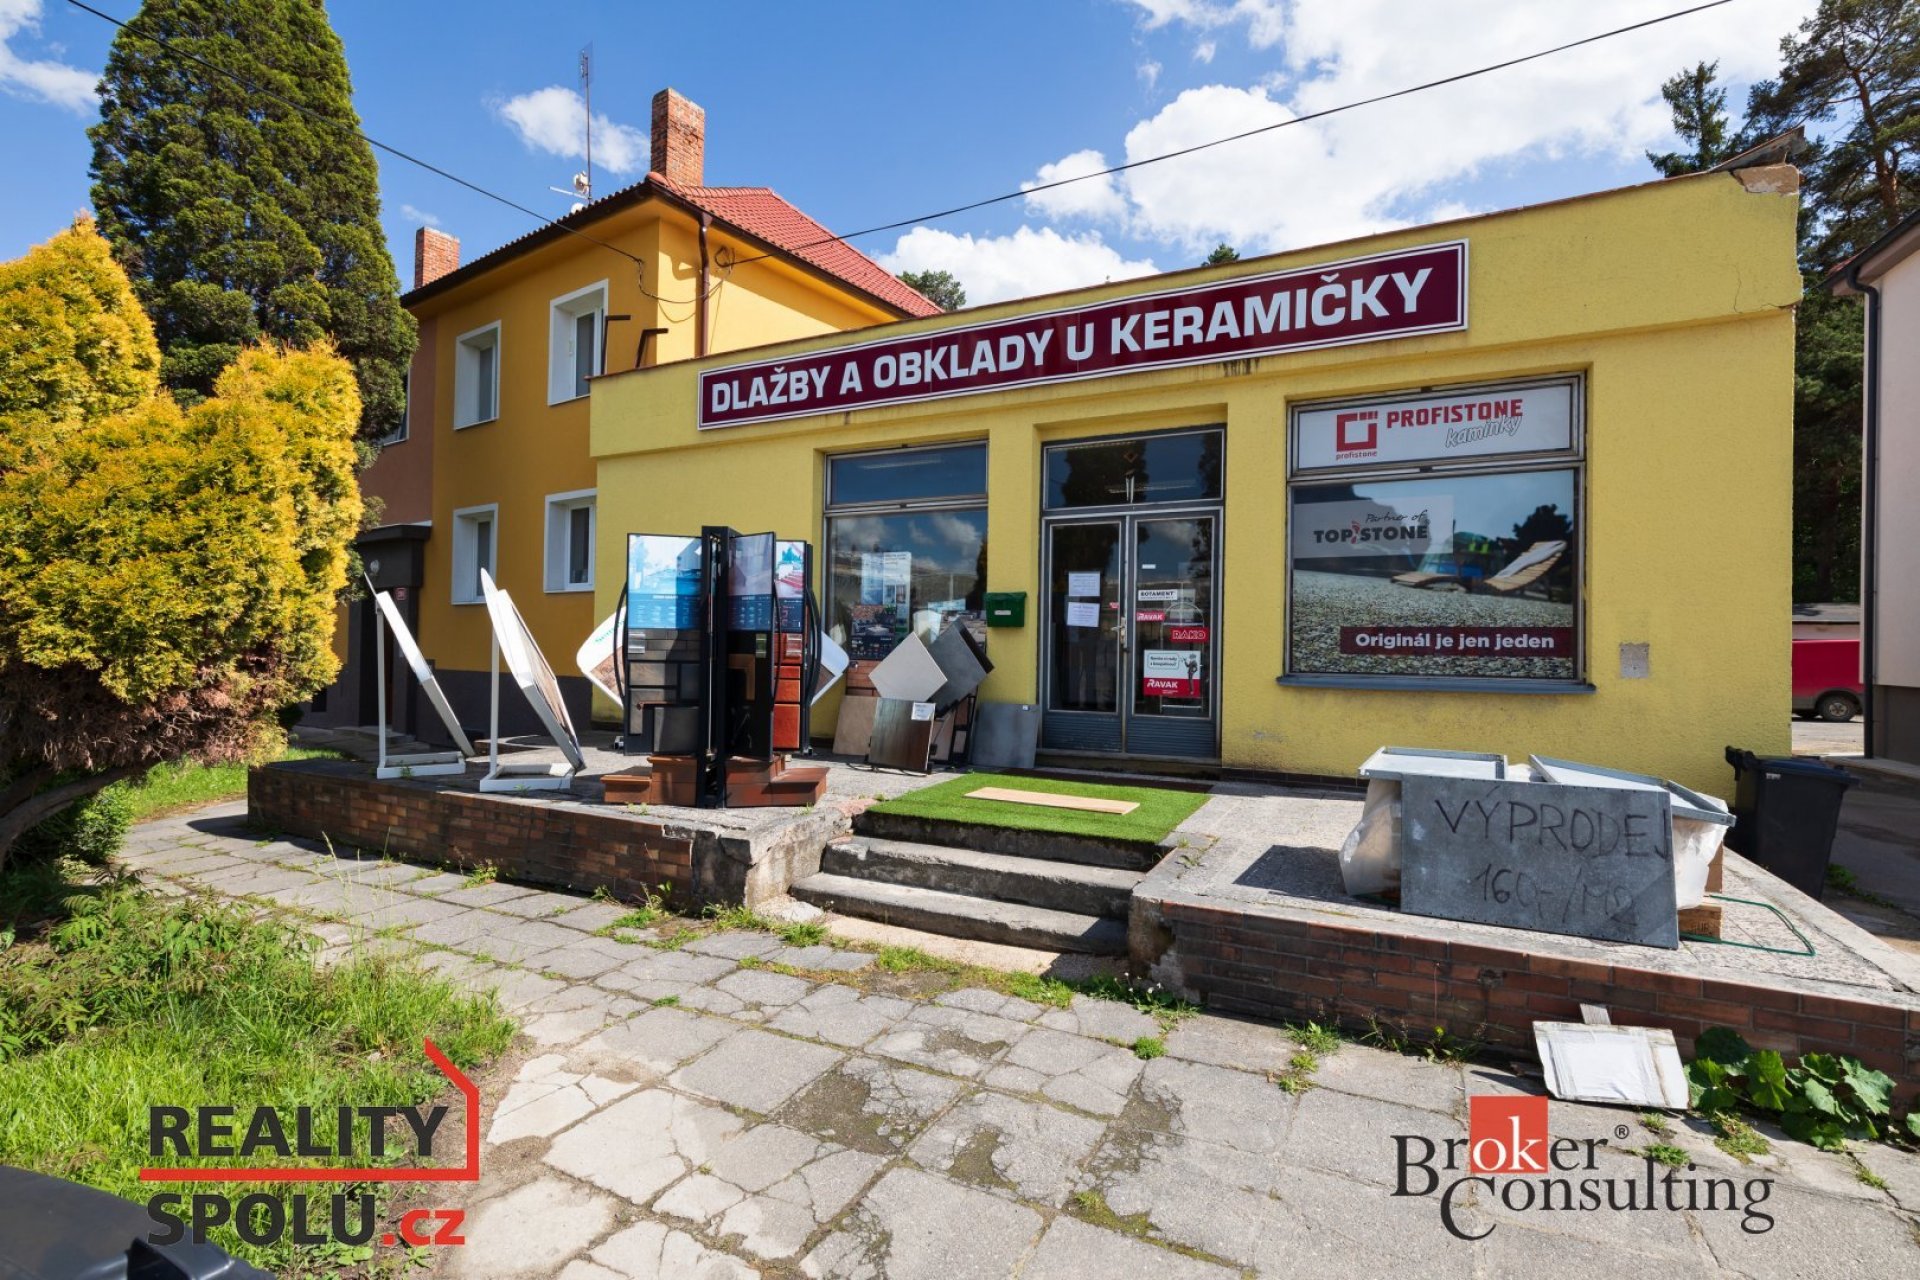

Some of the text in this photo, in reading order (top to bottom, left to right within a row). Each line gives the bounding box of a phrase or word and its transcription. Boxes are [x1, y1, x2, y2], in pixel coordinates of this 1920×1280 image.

[711, 267, 1433, 414] DLAŽBY A OBKLADY U KERAMIČKY
[1386, 399, 1523, 429] PROFISTONE
[1336, 450, 1377, 461] profistone
[1365, 512, 1408, 524] Partner
[1172, 629, 1206, 640] RAKO
[1355, 633, 1555, 650] Originál je jen jeden
[1146, 679, 1178, 689] RAVAK
[1434, 785, 1669, 861] VÝPRODEJ
